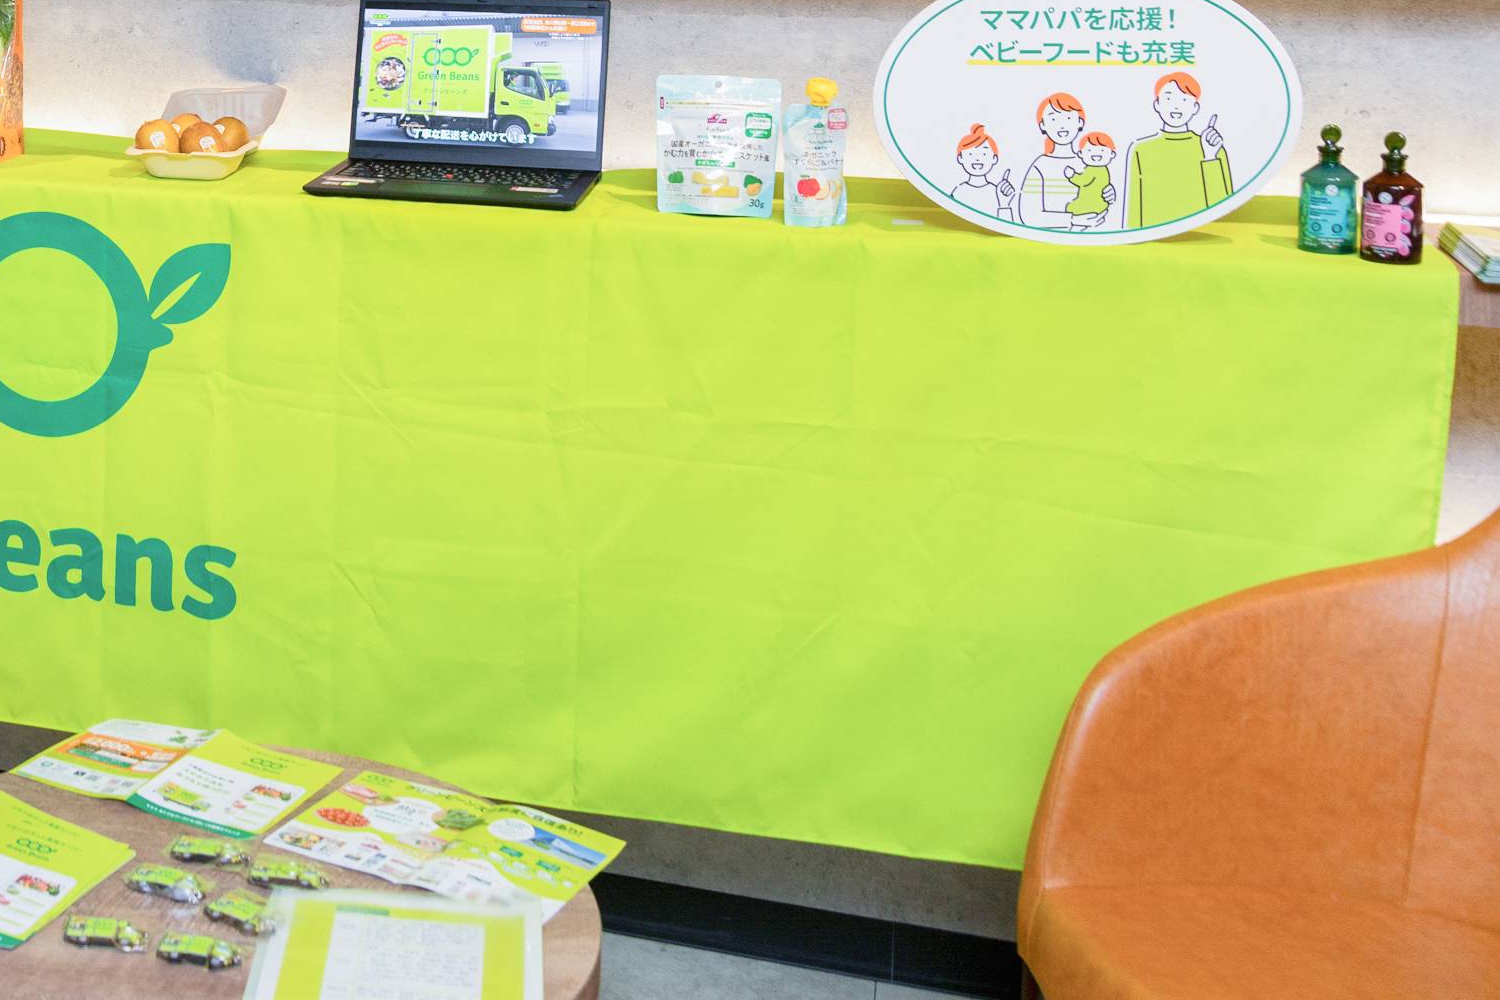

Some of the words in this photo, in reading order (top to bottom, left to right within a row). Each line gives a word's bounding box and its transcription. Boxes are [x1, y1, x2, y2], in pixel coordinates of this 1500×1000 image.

[979, 7, 1177, 32] ママパパを応援！
[969, 40, 1196, 65] ベビーフードも充実
[450, 72, 480, 81] Beans
